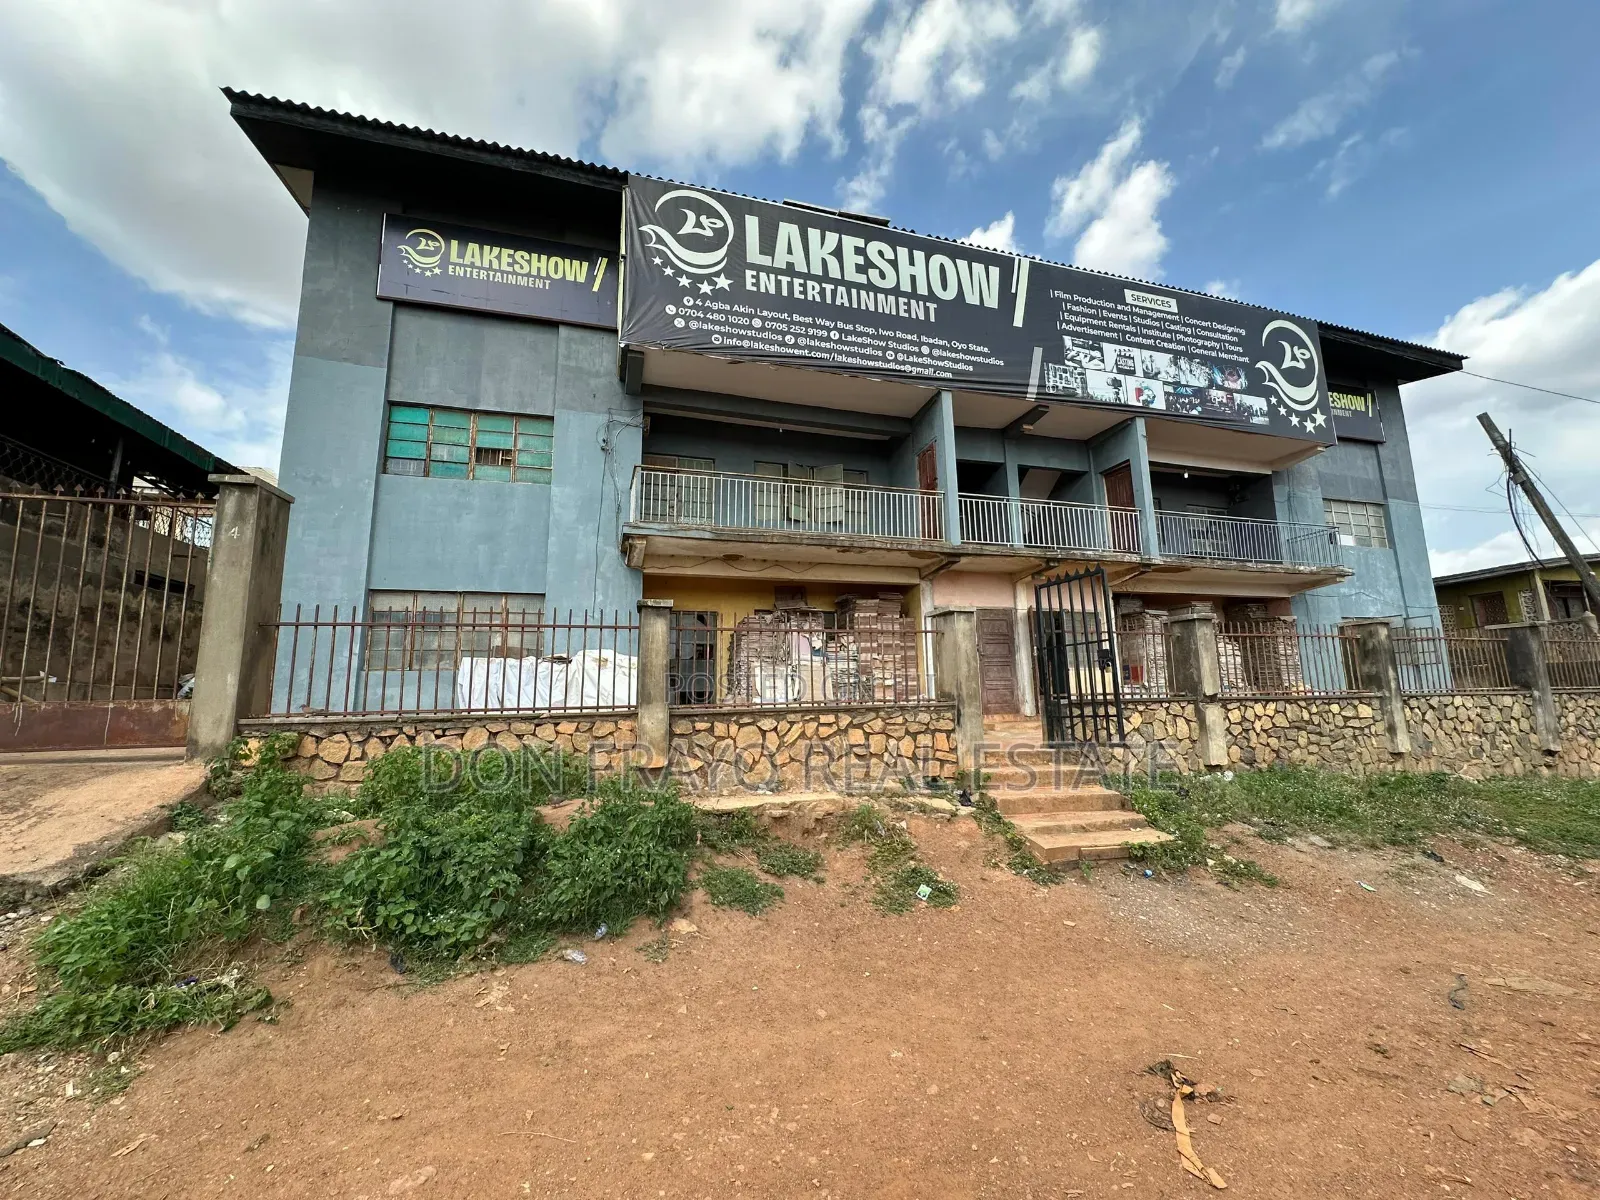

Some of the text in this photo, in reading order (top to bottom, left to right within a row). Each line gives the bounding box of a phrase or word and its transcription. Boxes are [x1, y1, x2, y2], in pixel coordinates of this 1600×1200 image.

[448, 266, 551, 290] ENTERTAINMENT
[450, 240, 588, 283] LAKESHOW
[744, 214, 1000, 309] LAKESHOW
[745, 269, 938, 322] ENTERTAINMENT
[1054, 290, 1072, 300] Film
[1073, 294, 1115, 309] Production
[1116, 304, 1131, 312] and
[1132, 306, 1180, 322] Management
[1185, 316, 1212, 328] Concert
[1212, 322, 1246, 335] Designing
[1131, 294, 1171, 308] SERVICES
[678, 307, 1004, 366] 0704 480 1020 0705 252 9199 LakeShow Studios @lakeshowstudios
[696, 298, 990, 353] 4 Agba Akin Layout, Best Way Bus Stop, Iwo Road, Ibadan, Oyo State.
[1061, 322, 1118, 339] Advertisement
[1126, 334, 1155, 345] Content
[1156, 340, 1186, 351] Creation
[1191, 346, 1217, 357] General
[1219, 352, 1250, 363] Merchant
[1064, 312, 1107, 327] Equipment
[1109, 321, 1136, 332] Rentals
[1142, 327, 1171, 338] Institute
[1176, 334, 1220, 349] Photography
[1225, 343, 1243, 352] Tours
[1067, 303, 1097, 314] Fashion
[1103, 310, 1128, 320] Events
[1133, 316, 1160, 327] Studios
[1165, 322, 1191, 334] Casting
[1196, 328, 1238, 342] Consultation
[688, 320, 973, 371] @lakeshowstudios @lakeshowstudios @LakeShowStudios
[1328, 392, 1365, 411] ESHOW
[228, 526, 240, 539] 4
